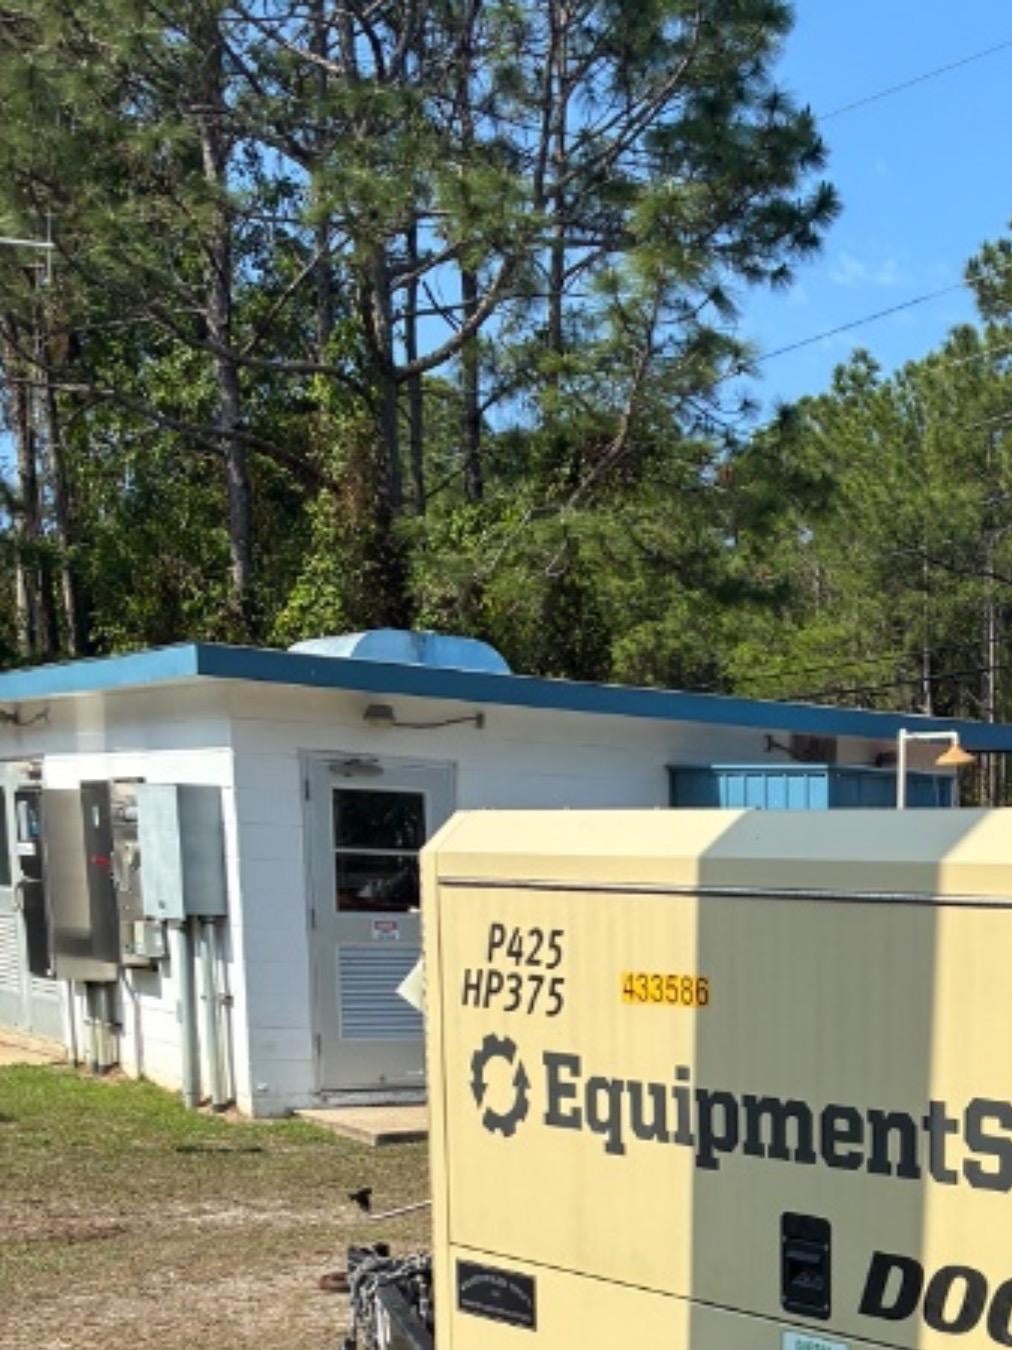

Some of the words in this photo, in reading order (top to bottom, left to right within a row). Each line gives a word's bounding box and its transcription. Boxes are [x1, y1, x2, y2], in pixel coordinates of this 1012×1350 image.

[486, 922, 564, 969] P425
[462, 968, 565, 1017] HP375
[622, 974, 710, 1006] 433586
